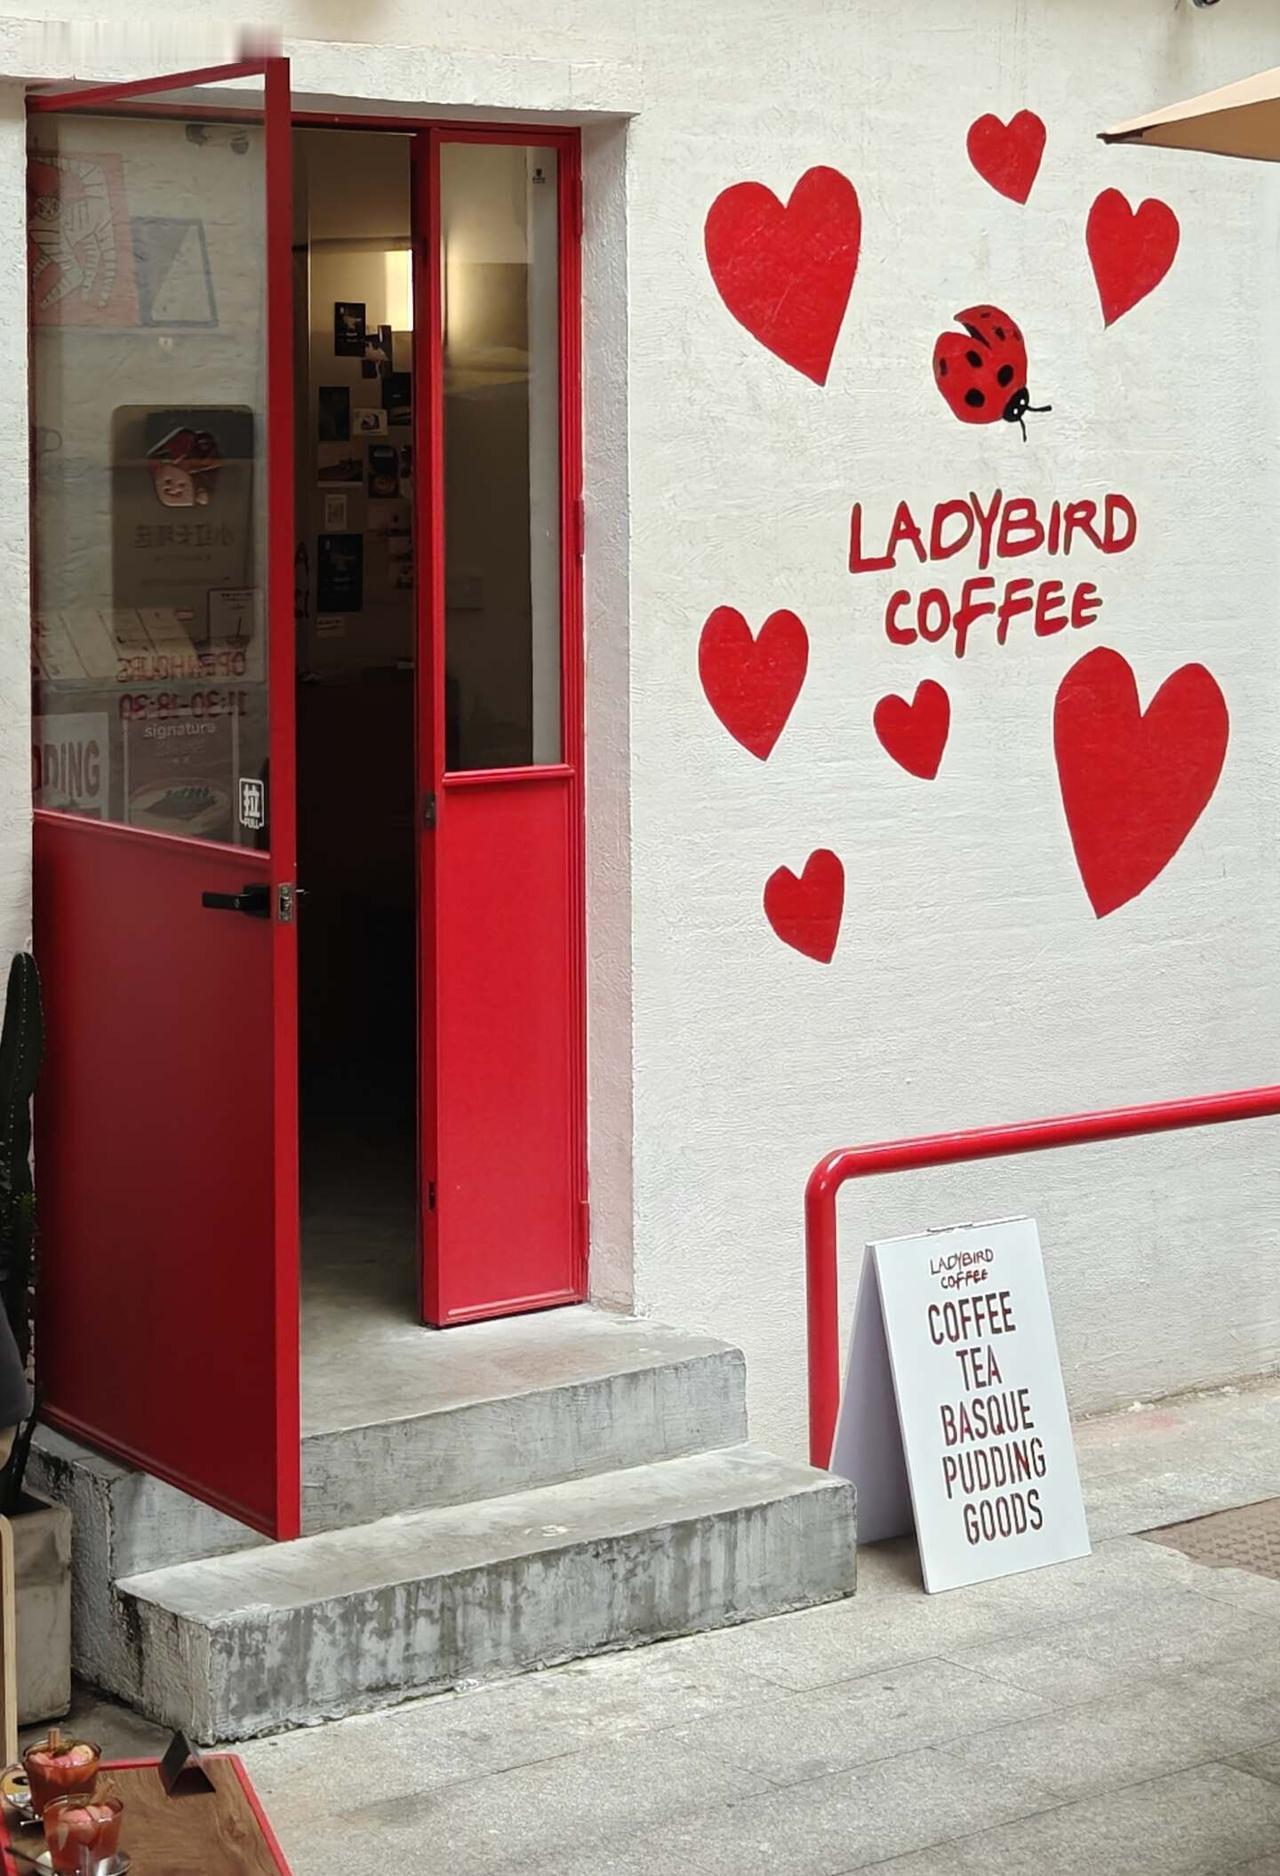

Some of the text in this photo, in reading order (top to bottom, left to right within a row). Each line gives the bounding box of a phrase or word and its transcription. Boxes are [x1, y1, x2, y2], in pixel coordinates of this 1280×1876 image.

[849, 488, 1137, 574] LADYBIRD
[885, 576, 1103, 659] COFFEE
[143, 720, 217, 741] signature
[243, 784, 260, 818] 拉
[929, 1248, 995, 1275] LADYBIRD
[940, 1268, 989, 1291] COFFEE
[927, 1290, 1017, 1346] COFFEE
[955, 1344, 1003, 1392] TEA
[940, 1388, 1035, 1447] BASQUE
[942, 1436, 1047, 1500] PUDDING
[963, 1488, 1044, 1547] GOODS
